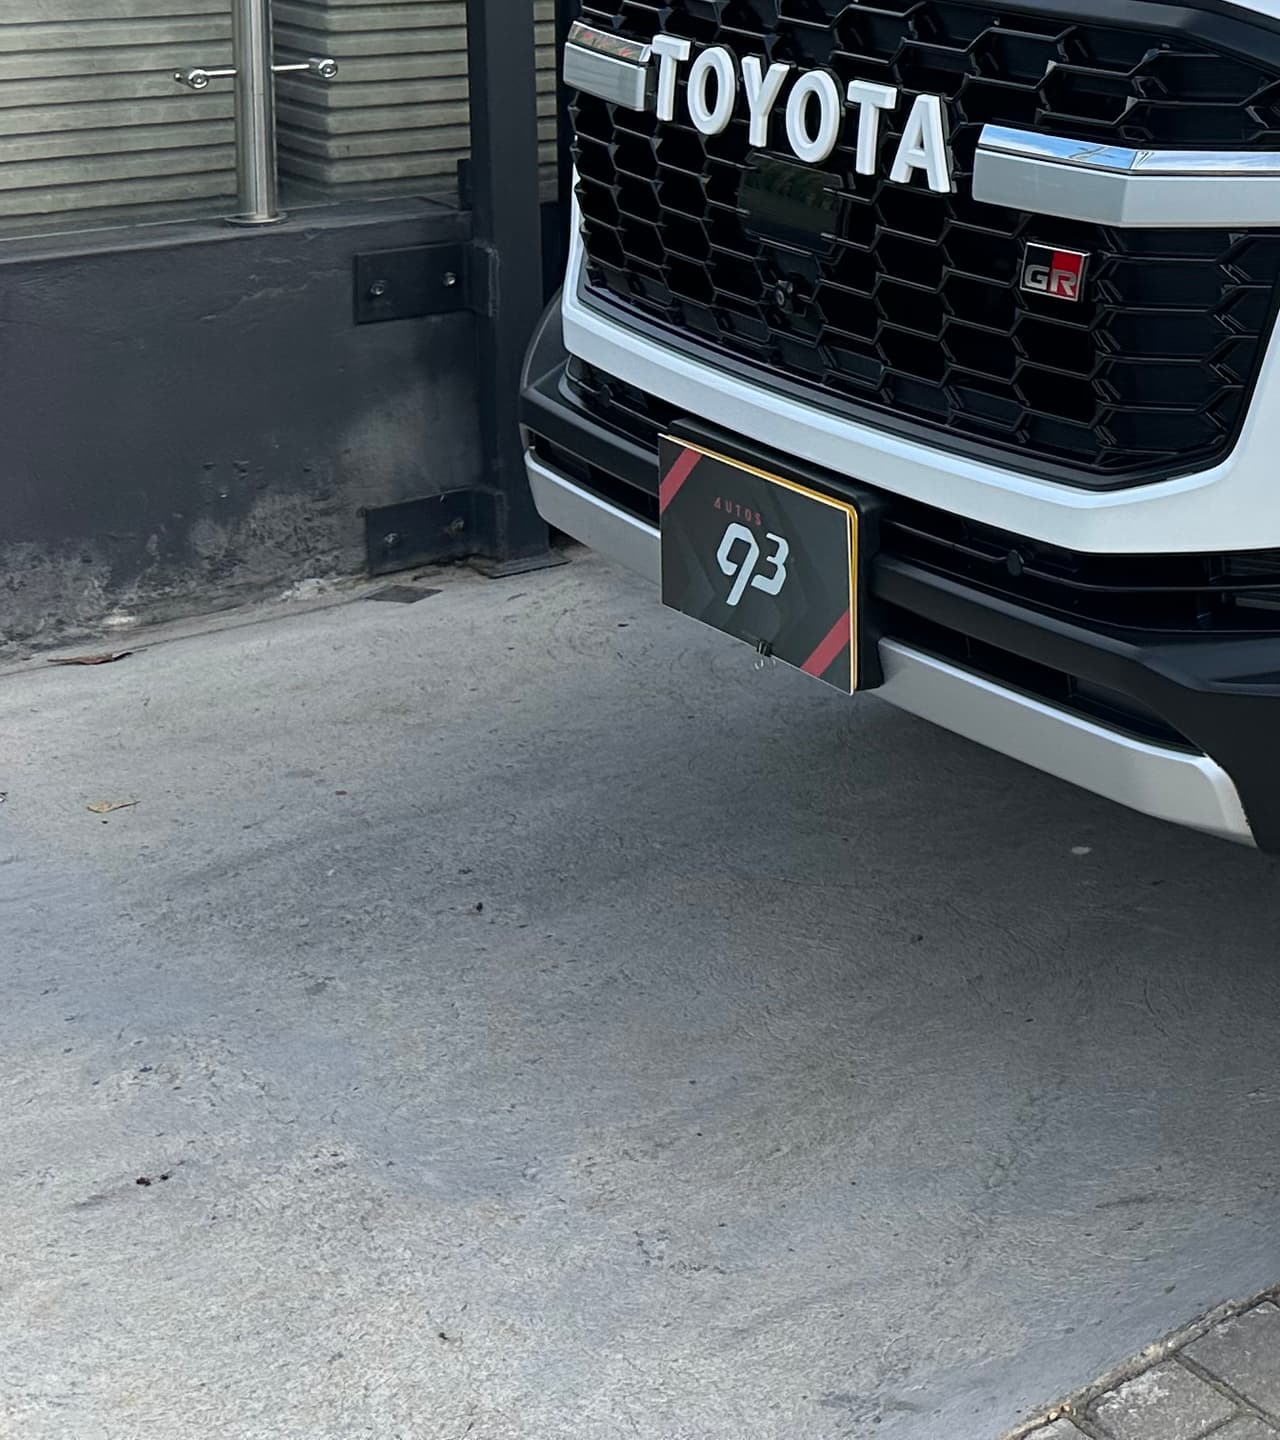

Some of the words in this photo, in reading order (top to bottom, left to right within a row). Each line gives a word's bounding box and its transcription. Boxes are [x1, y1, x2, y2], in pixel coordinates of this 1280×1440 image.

[651, 34, 951, 193] TOYOTA
[1025, 264, 1077, 297] GR
[713, 497, 762, 526] AUTOS
[716, 522, 789, 606] 93
